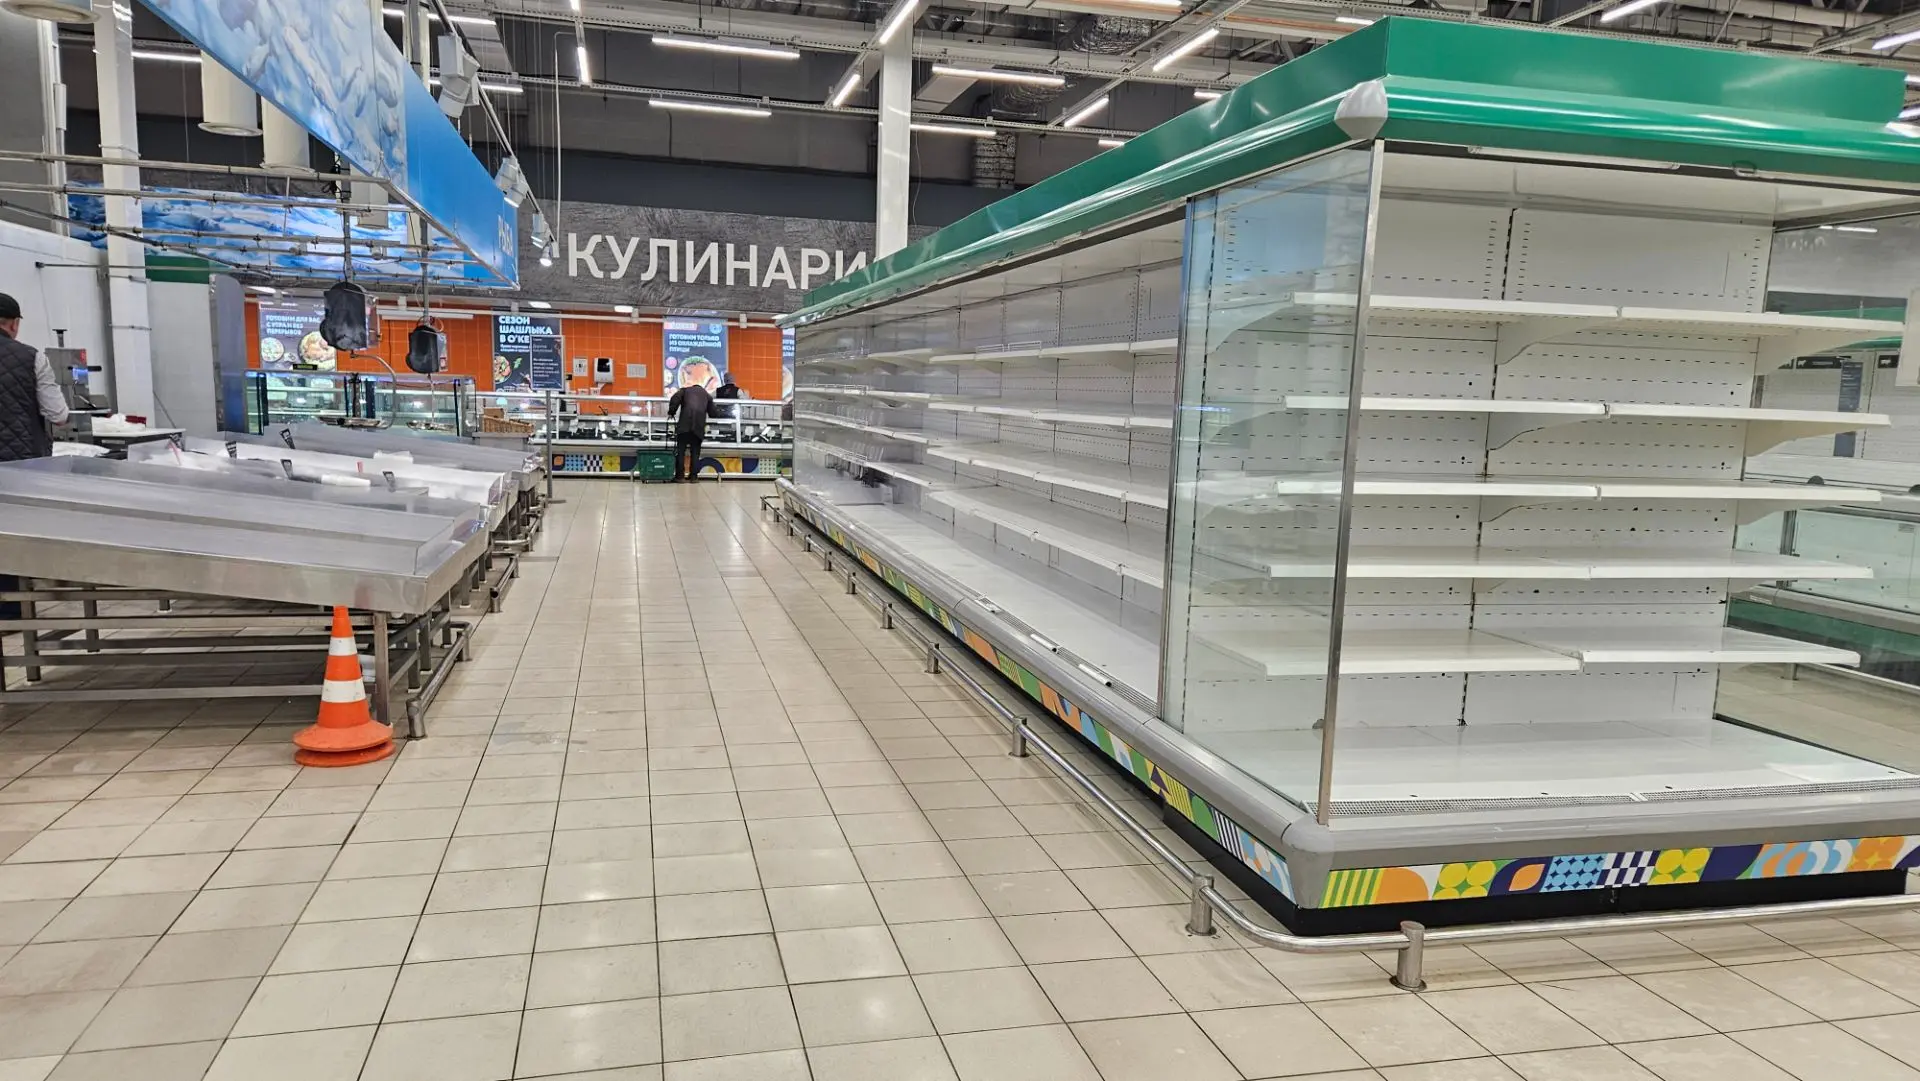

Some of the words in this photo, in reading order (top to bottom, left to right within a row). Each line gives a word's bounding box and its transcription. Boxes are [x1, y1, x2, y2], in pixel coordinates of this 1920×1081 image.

[498, 316, 530, 325] СЕЗОН
[499, 325, 553, 335] ШАШЛЫКА
[500, 334, 506, 343] В
